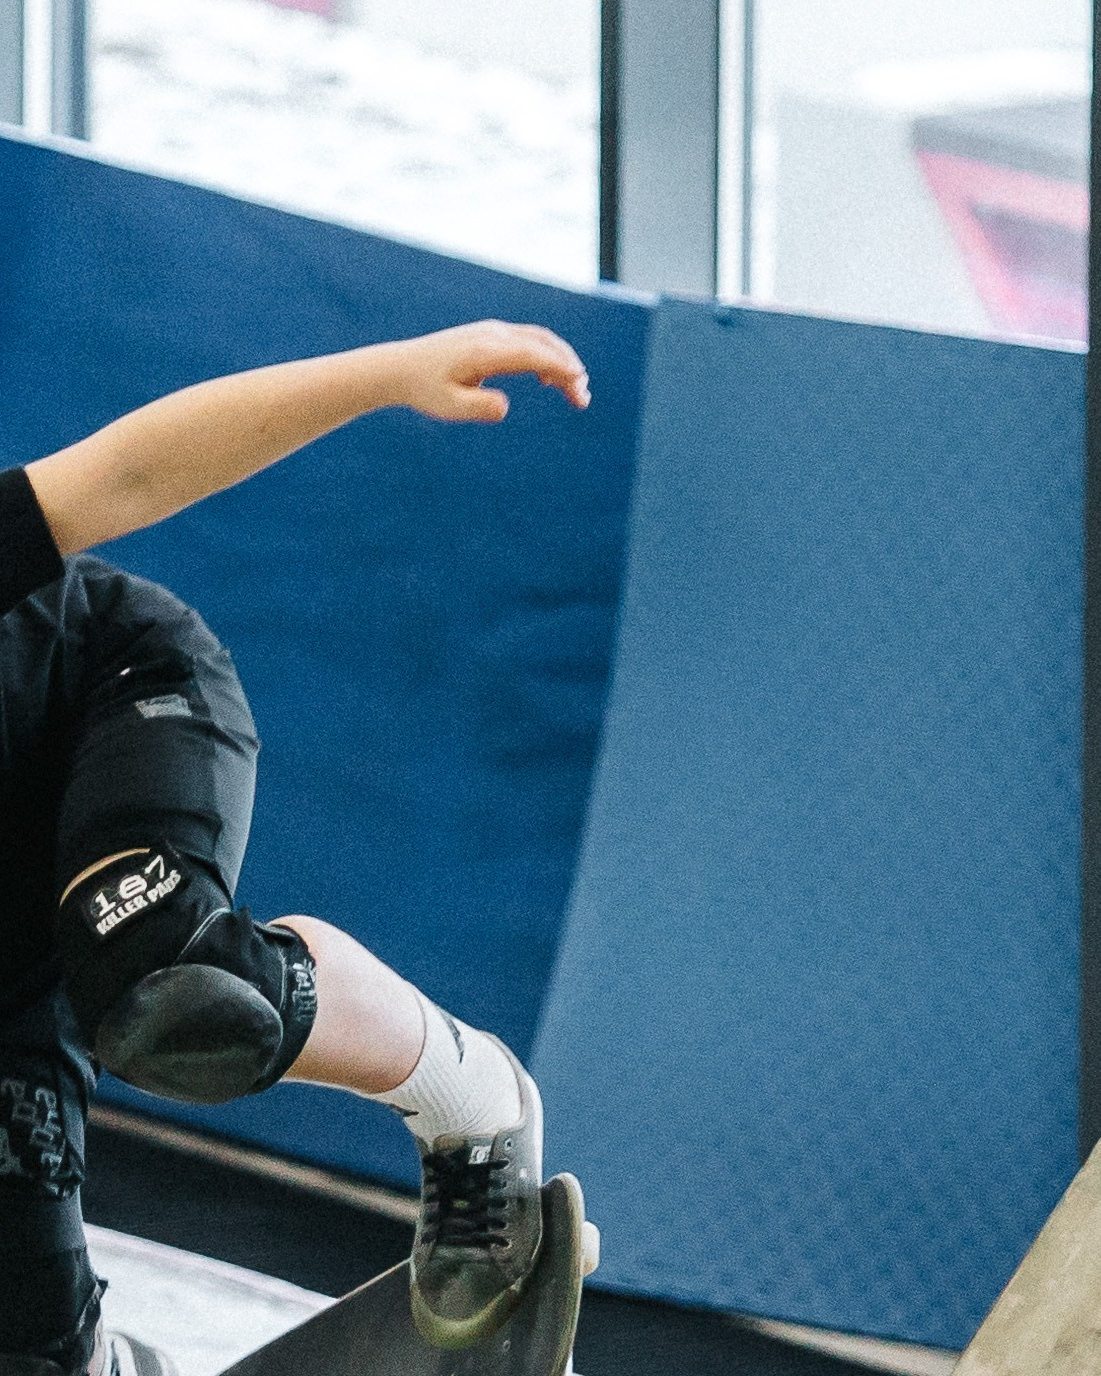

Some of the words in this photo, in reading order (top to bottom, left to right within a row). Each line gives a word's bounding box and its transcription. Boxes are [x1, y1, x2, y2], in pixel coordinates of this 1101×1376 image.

[95, 854, 165, 917] 187
[96, 893, 148, 935] KILLER
[147, 869, 181, 902] PADS
